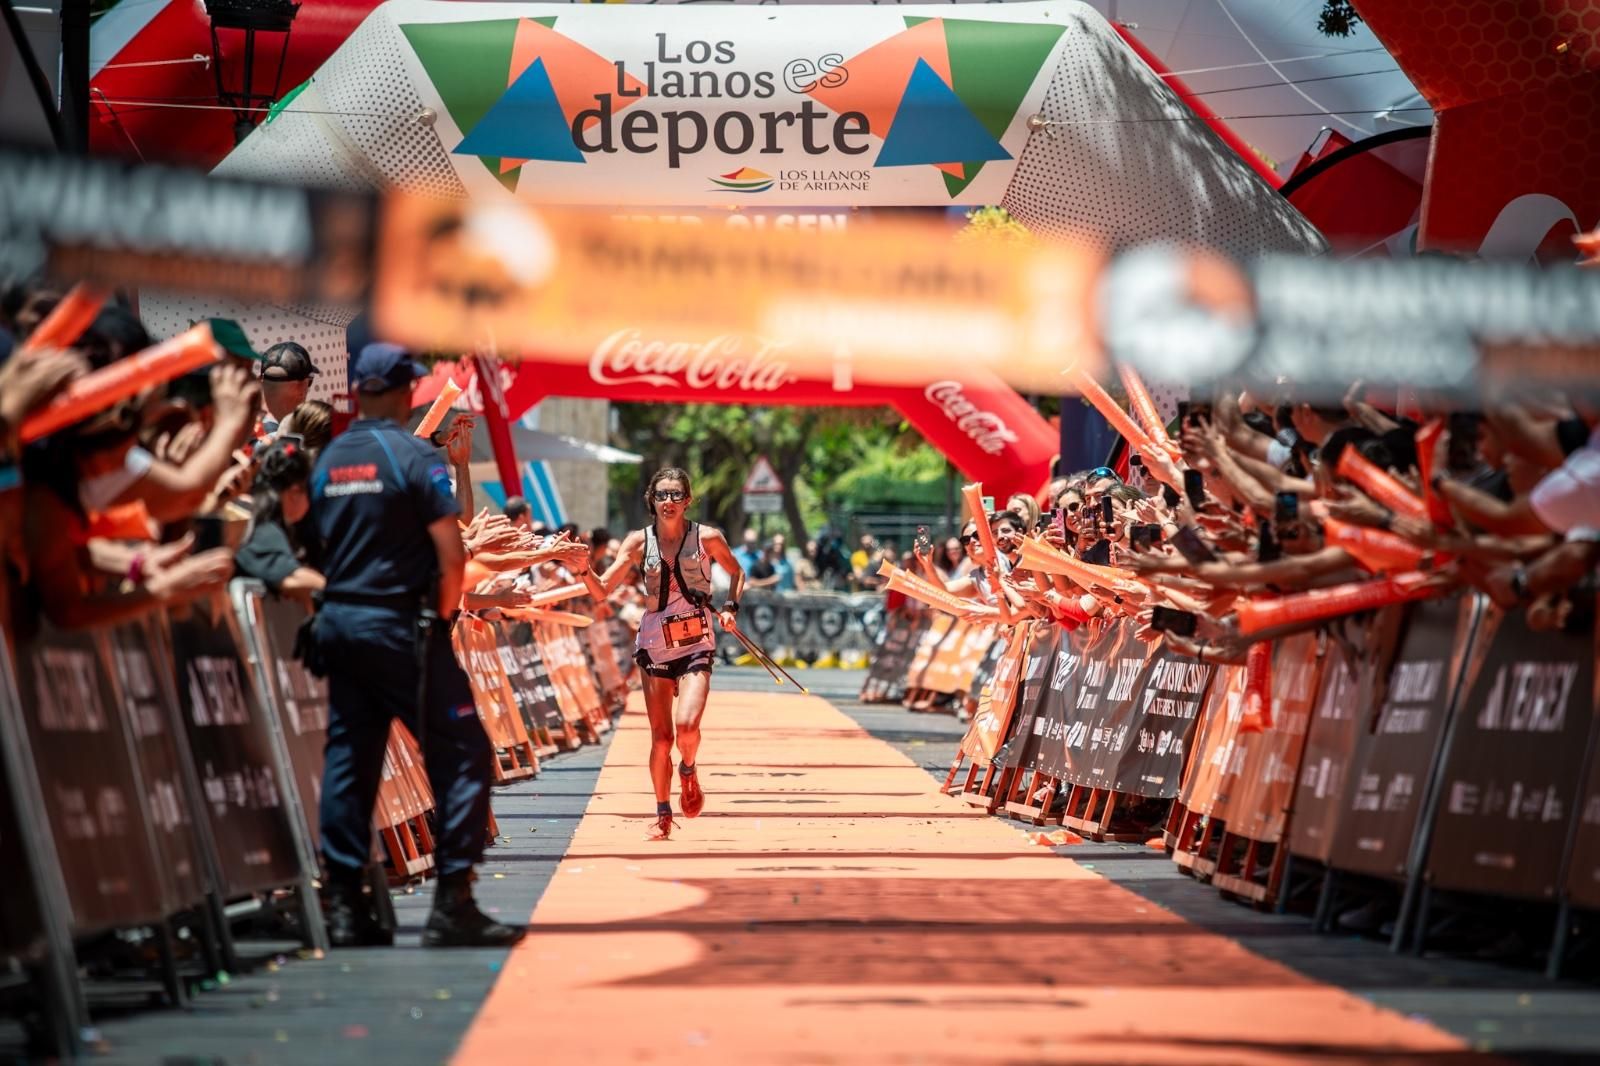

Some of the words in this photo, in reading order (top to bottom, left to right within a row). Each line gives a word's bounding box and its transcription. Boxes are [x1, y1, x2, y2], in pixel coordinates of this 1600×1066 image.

[655, 33, 736, 64] Los
[614, 61, 775, 98] Llanos
[783, 52, 849, 94] es
[571, 93, 870, 168] deporte
[780, 170, 808, 181] LOS
[813, 170, 871, 181] LLANOS
[780, 182, 801, 191] DE
[803, 182, 870, 191] ARIDANE
[682, 622, 689, 633] 4
